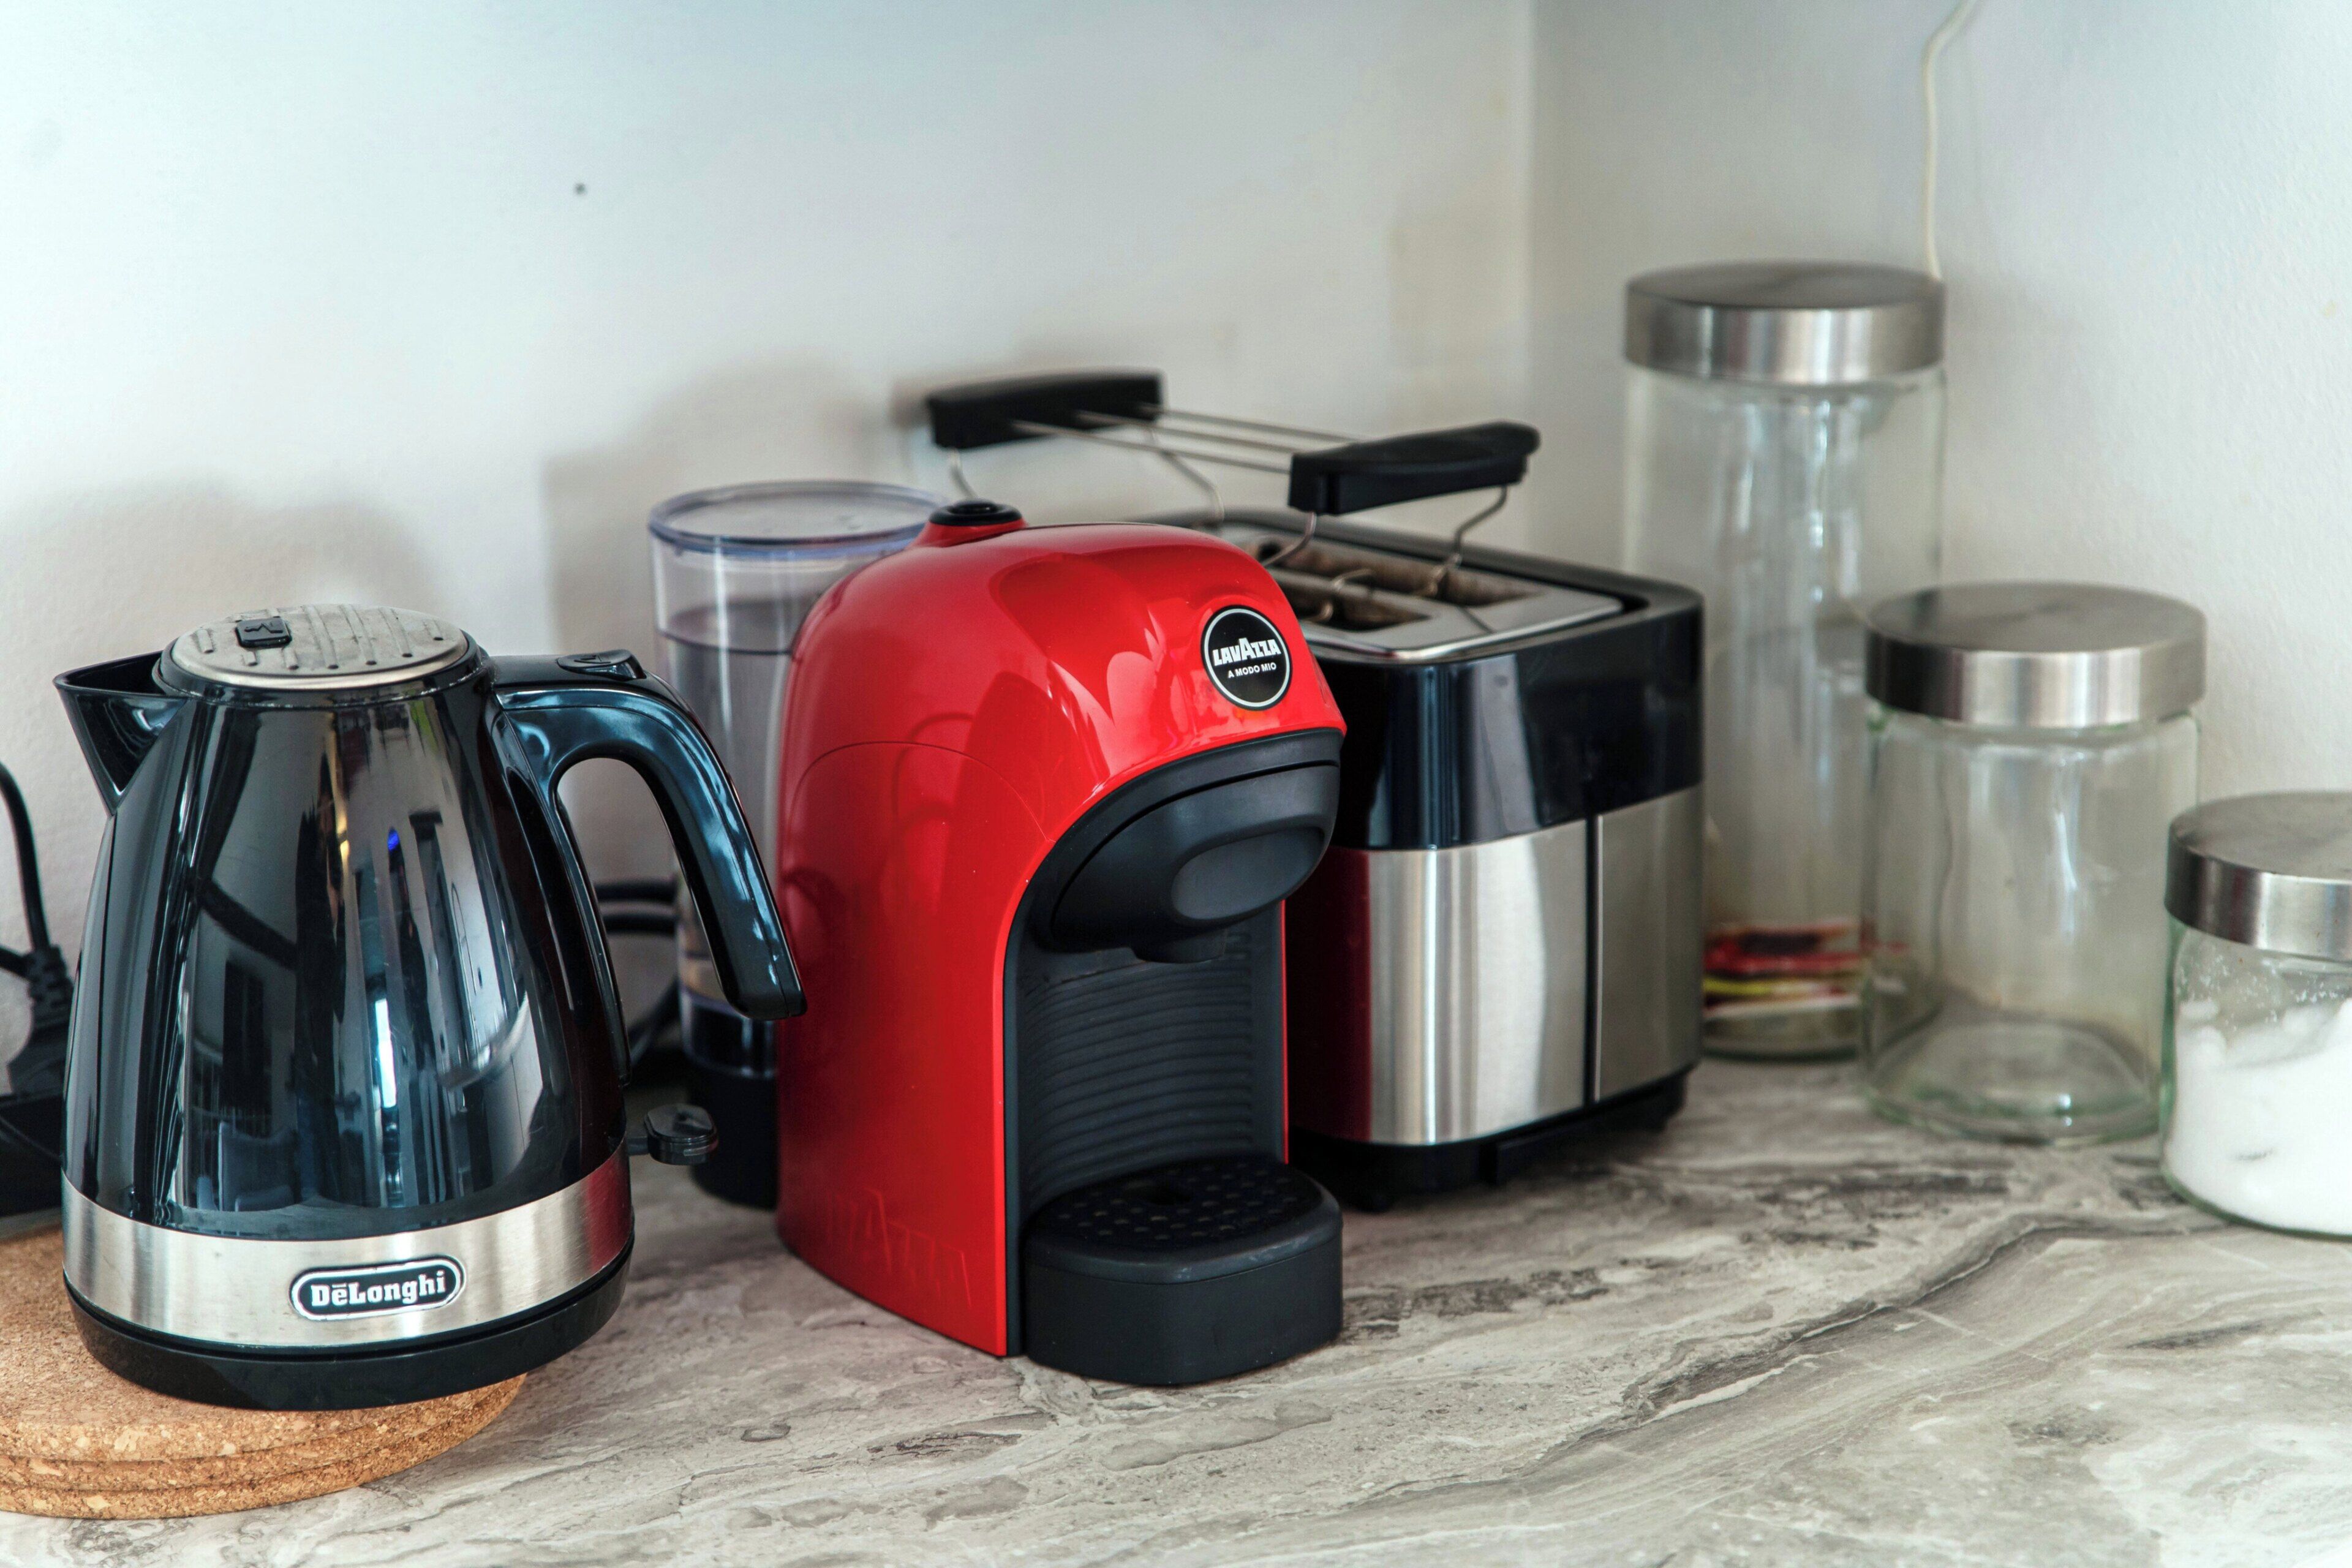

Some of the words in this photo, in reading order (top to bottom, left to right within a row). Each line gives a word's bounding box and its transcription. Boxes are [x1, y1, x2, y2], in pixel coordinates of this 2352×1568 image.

[1212, 638, 1281, 666] LAVAZZA
[1228, 669, 1235, 678] A
[1235, 665, 1261, 676] MODO
[1261, 662, 1276, 672] MIO
